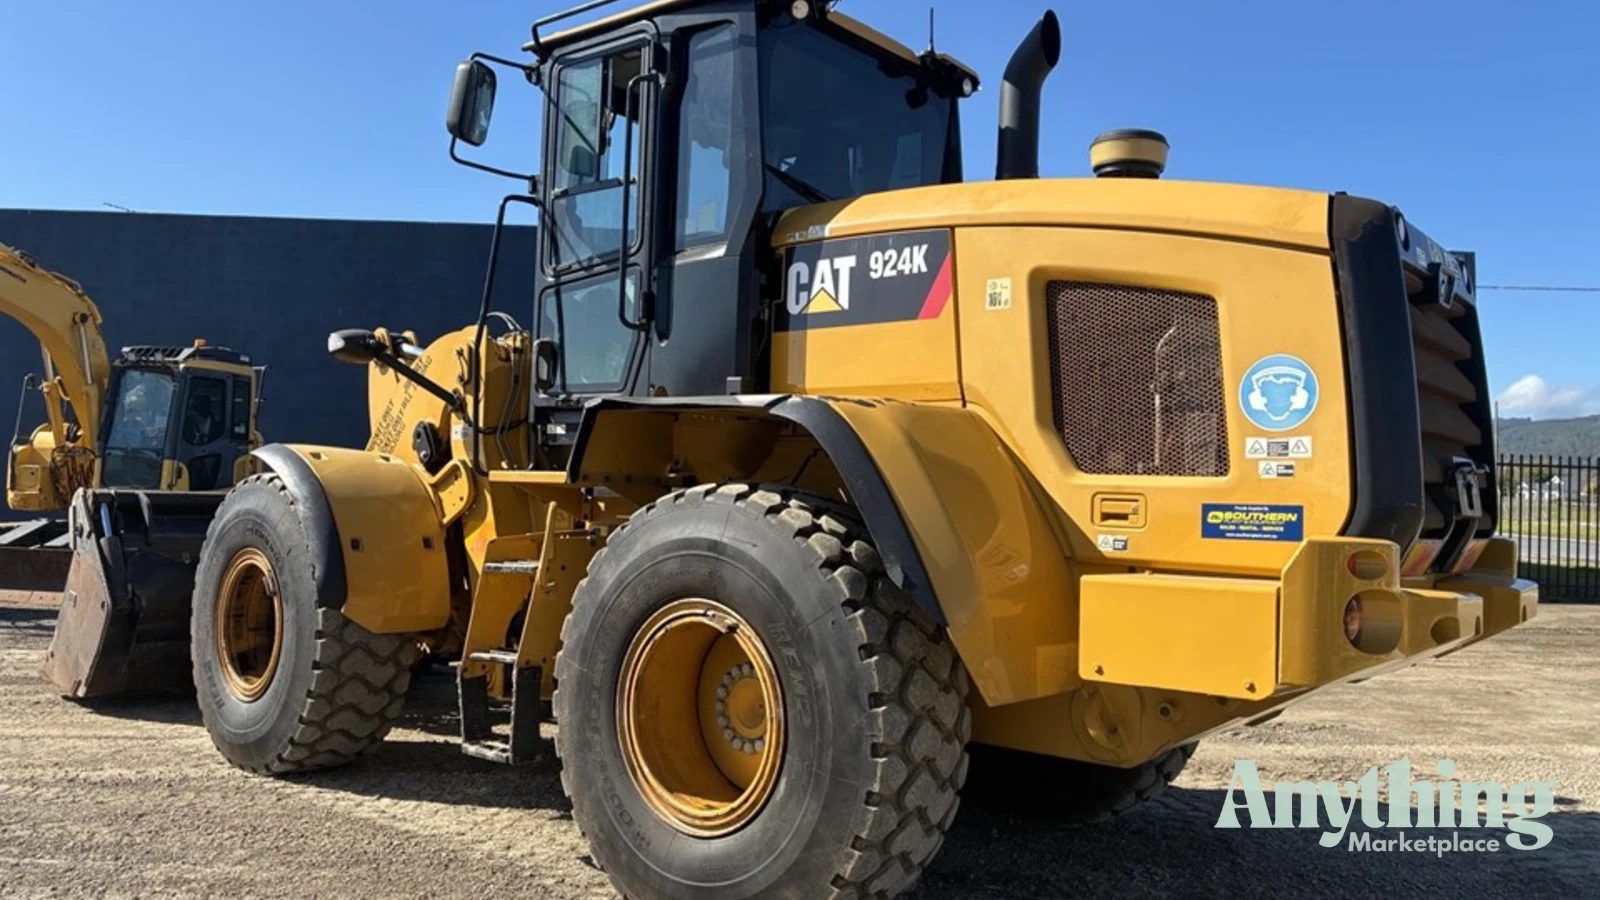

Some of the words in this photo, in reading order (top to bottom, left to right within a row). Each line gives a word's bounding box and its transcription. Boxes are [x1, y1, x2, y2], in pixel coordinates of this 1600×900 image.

[786, 254, 857, 316] CAT
[869, 244, 929, 279] 924K
[1223, 511, 1298, 522] SOUTHERN
